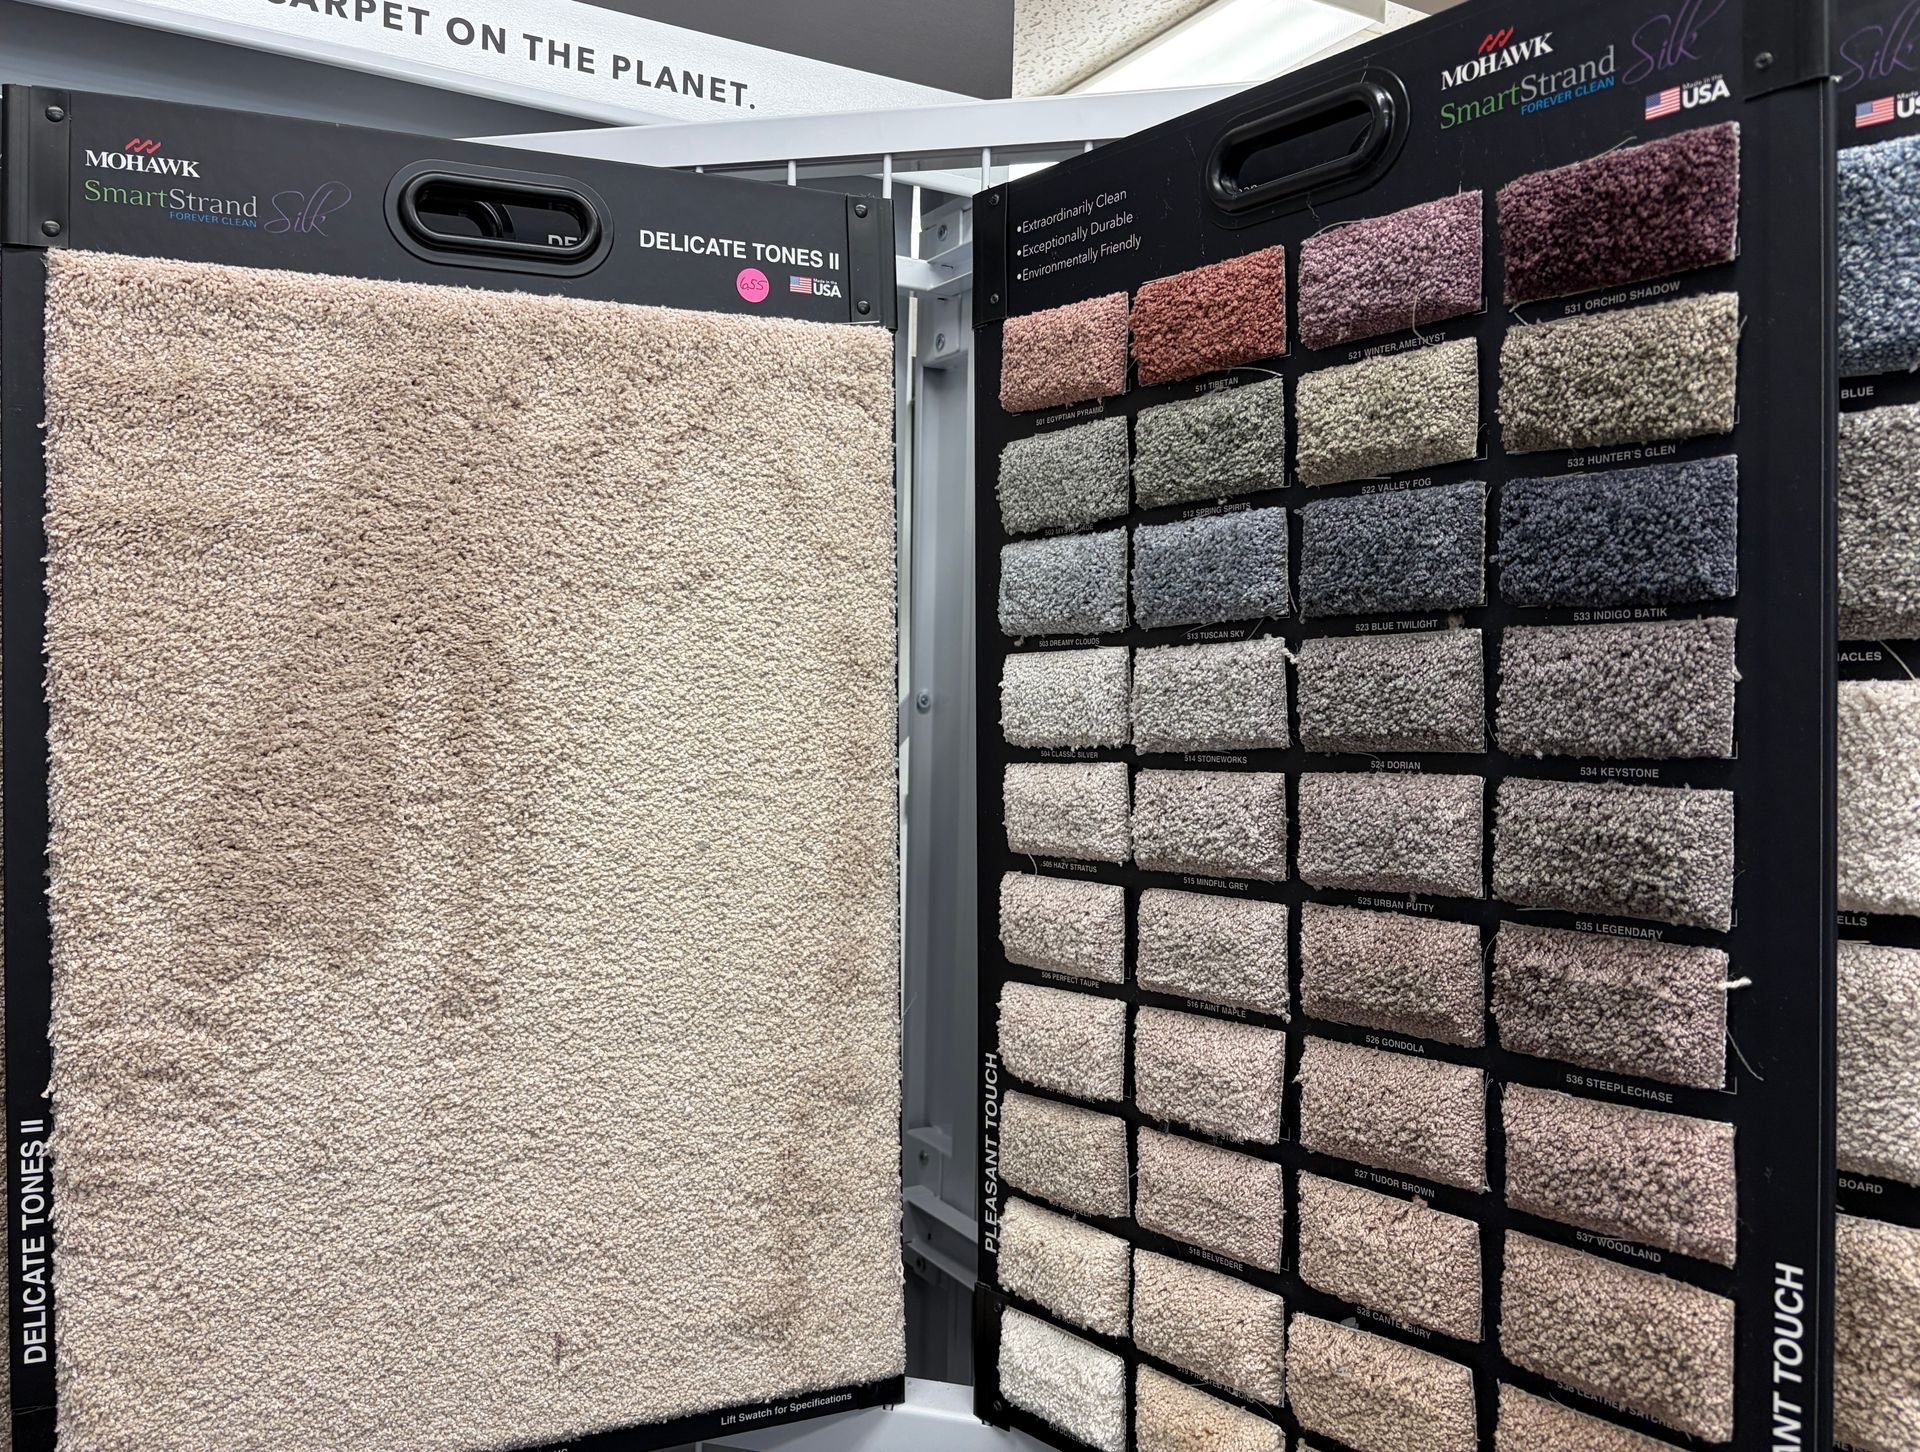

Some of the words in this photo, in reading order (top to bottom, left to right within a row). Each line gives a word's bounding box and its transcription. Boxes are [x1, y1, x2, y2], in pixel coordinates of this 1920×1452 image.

[267, 0, 430, 36] RPET
[446, 17, 505, 54] ON
[523, 33, 595, 74] THE
[612, 54, 755, 110] PLANET.
[1440, 32, 1553, 91] MOHAWK
[1440, 44, 1616, 130] SmartStrand
[1521, 88, 1573, 116] FOREVER
[1575, 76, 1615, 98] CLEAN
[1682, 79, 1731, 109] USA
[85, 149, 200, 178] MOHAWK
[84, 179, 258, 218] SmartStrand
[264, 181, 351, 237] Silk
[170, 211, 219, 224] FOREVER
[222, 215, 257, 228] CLEAN
[1022, 199, 1094, 234] Extraordinarily
[1096, 190, 1127, 208] Clean
[1022, 226, 1088, 258] Exceptionally
[1090, 211, 1133, 236] Durable
[639, 229, 747, 259] DELICATE
[753, 243, 824, 268] TONES
[829, 253, 840, 270] II
[1022, 248, 1098, 282] Environmentally
[1100, 233, 1142, 257] Friendly
[813, 282, 842, 298] USA
[1564, 303, 1581, 314] 531
[1584, 293, 1627, 310] ORCHID
[1630, 281, 1681, 300] SHADOW
[1348, 350, 1361, 360] 521
[1364, 342, 1396, 357] WINTER
[1398, 332, 1446, 349] AMETHYST
[1195, 383, 1206, 392] 511
[1208, 377, 1239, 390] TIBETAN
[1841, 386, 1874, 399] BLUE
[1047, 411, 1076, 424] EGYPTIAN
[1076, 406, 1104, 417] PYRAMID
[1567, 457, 1585, 468] 532
[1587, 449, 1641, 465] HUNTER'S
[1644, 444, 1676, 458] GLEN
[1361, 485, 1376, 494] 522
[1377, 480, 1411, 492] VALLEY
[1413, 477, 1432, 487] FOG
[1182, 510, 1194, 518] 512
[1195, 506, 1222, 516] SPRING
[1223, 502, 1251, 513] SPIRITS
[1355, 623, 1369, 632] 523
[1371, 622, 1394, 631] BLUE
[1396, 619, 1438, 630] TWILIGHT
[1573, 612, 1590, 621] 533
[1593, 609, 1631, 620] INDIGO
[1634, 607, 1668, 618] BATIK
[1049, 639, 1074, 647] DREAMY
[1075, 637, 1100, 646] CLOUDS
[1187, 632, 1199, 640] 513
[1200, 630, 1229, 639] TUSCAN
[1230, 630, 1245, 638] SKY
[1051, 750, 1077, 758] CLASSIC
[1077, 751, 1099, 759] SILVER
[1184, 754, 1196, 762] 514
[1197, 754, 1248, 764] STONEWORKS
[1370, 760, 1385, 769] 524
[1387, 760, 1421, 770] DORIAN
[1580, 767, 1597, 776] 534
[1600, 767, 1660, 778] KEYSTONE
[1053, 862, 1069, 870] HAZY
[1070, 863, 1097, 873] STRATUS
[1183, 876, 1195, 885] 515
[1196, 878, 1227, 889] MINDFUL
[1228, 881, 1249, 891] GREY
[1357, 896, 1372, 905] 525
[1374, 898, 1404, 910] URBAN
[1406, 902, 1434, 913] PUTTY
[1575, 921, 1593, 932] 535
[1596, 923, 1663, 940] LEGENDARY
[1052, 973, 1078, 984] PERFECT
[1080, 978, 1100, 989] TAUPE
[1187, 1000, 1199, 1009] 516
[1200, 1002, 1220, 1013] FAINT
[1221, 1006, 1247, 1018] MAPLE
[1365, 1034, 1380, 1045] 526
[1382, 1037, 1425, 1053] GONDOLA
[985, 1052, 998, 1128] TOUCH
[1565, 1073, 1584, 1085] 536
[1586, 1077, 1673, 1104] STEEPLECHASE
[20, 1119, 44, 1134] II
[20, 1139, 45, 1231] TONES
[985, 1134, 998, 1254] PLEASANT
[1354, 1168, 1368, 1179] 527
[1370, 1172, 1400, 1188] TUDOR
[1402, 1181, 1435, 1198] BROWN
[1838, 1178, 1883, 1194] BOARD
[1576, 1231, 1594, 1243] 537
[1596, 1236, 1662, 1263] WOODLAND
[1202, 1250, 1244, 1272] BELVEDERE
[22, 1235, 47, 1365] DELICATE
[1356, 1305, 1371, 1318] 528
[1372, 1312, 1432, 1340] CANTEBURY
[1773, 1262, 1804, 1384] TOUCH
[721, 1412, 736, 1426] Lift
[738, 1407, 773, 1422] Swatch
[774, 1404, 788, 1416] for
[789, 1391, 852, 1415] Specifications
[1772, 1390, 1802, 1452] NT
